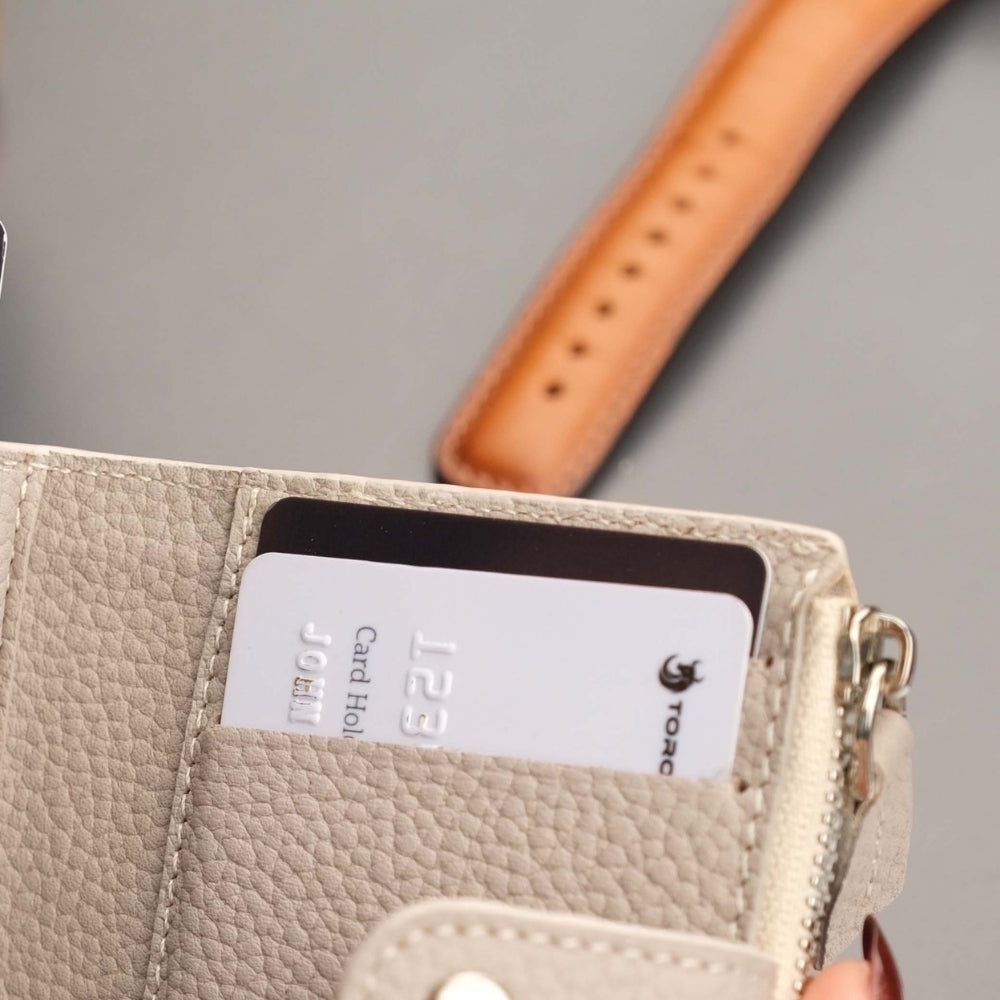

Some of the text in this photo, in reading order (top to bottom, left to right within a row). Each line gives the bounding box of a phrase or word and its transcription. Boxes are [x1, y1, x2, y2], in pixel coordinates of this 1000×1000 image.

[287, 621, 333, 727] JOHN
[342, 626, 378, 739] Card Hol
[401, 629, 458, 748] 123
